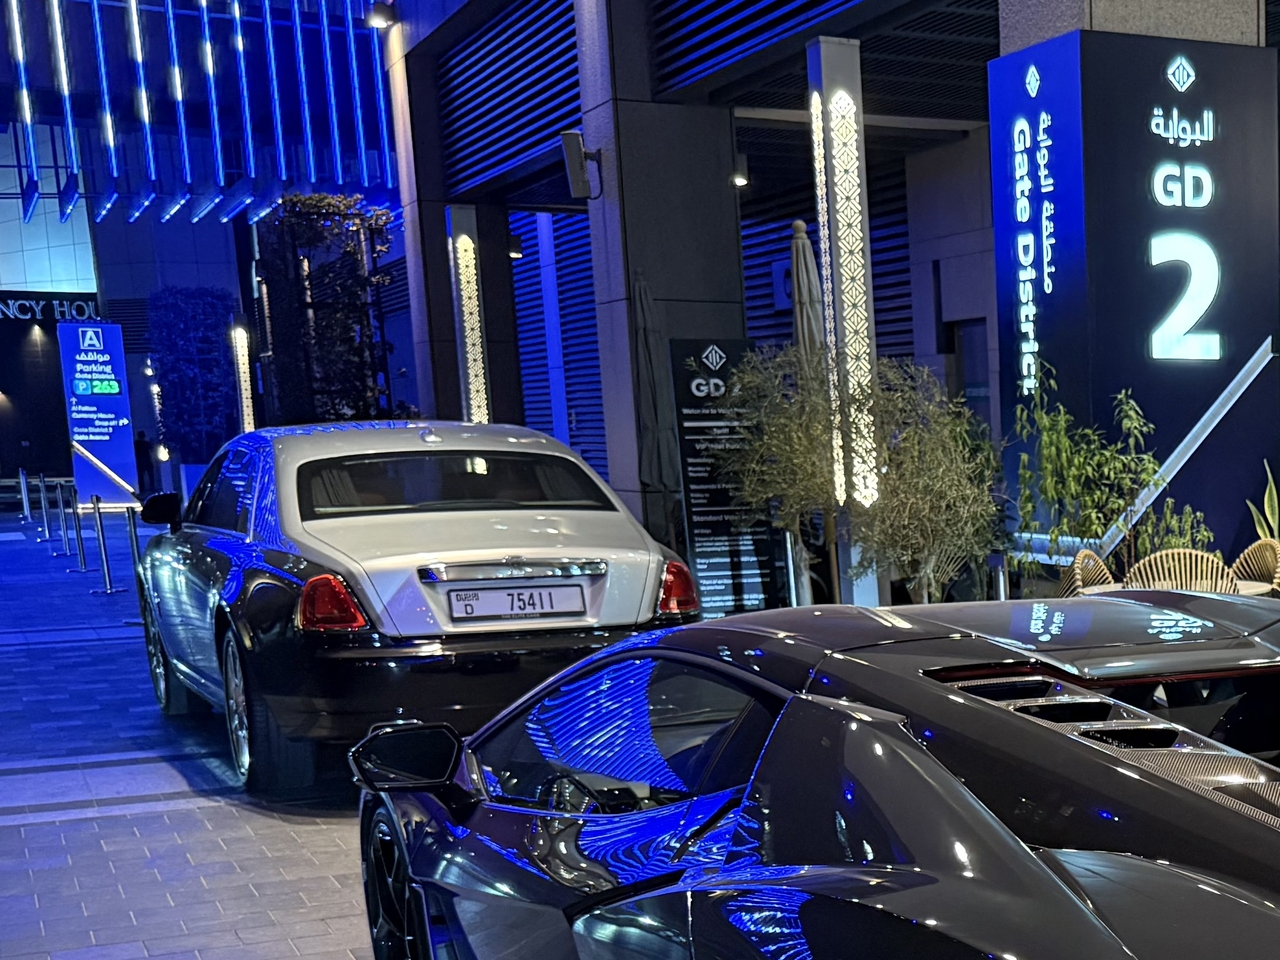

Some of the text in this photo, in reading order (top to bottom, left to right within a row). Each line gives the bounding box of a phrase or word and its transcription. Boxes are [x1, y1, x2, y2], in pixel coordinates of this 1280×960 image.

[1151, 107, 1214, 148] البوابة
[1153, 163, 1213, 208] GD
[1036, 111, 1056, 295] منطقة البوابة
[1013, 117, 1040, 396] Gate District
[1151, 229, 1221, 360] 2
[83, 330, 101, 348] A
[75, 352, 110, 362] مواقف
[76, 363, 112, 373] Parking
[92, 380, 120, 394] 263
[691, 378, 725, 397] GD
[464, 603, 474, 615] D
[507, 592, 554, 611] 75411
